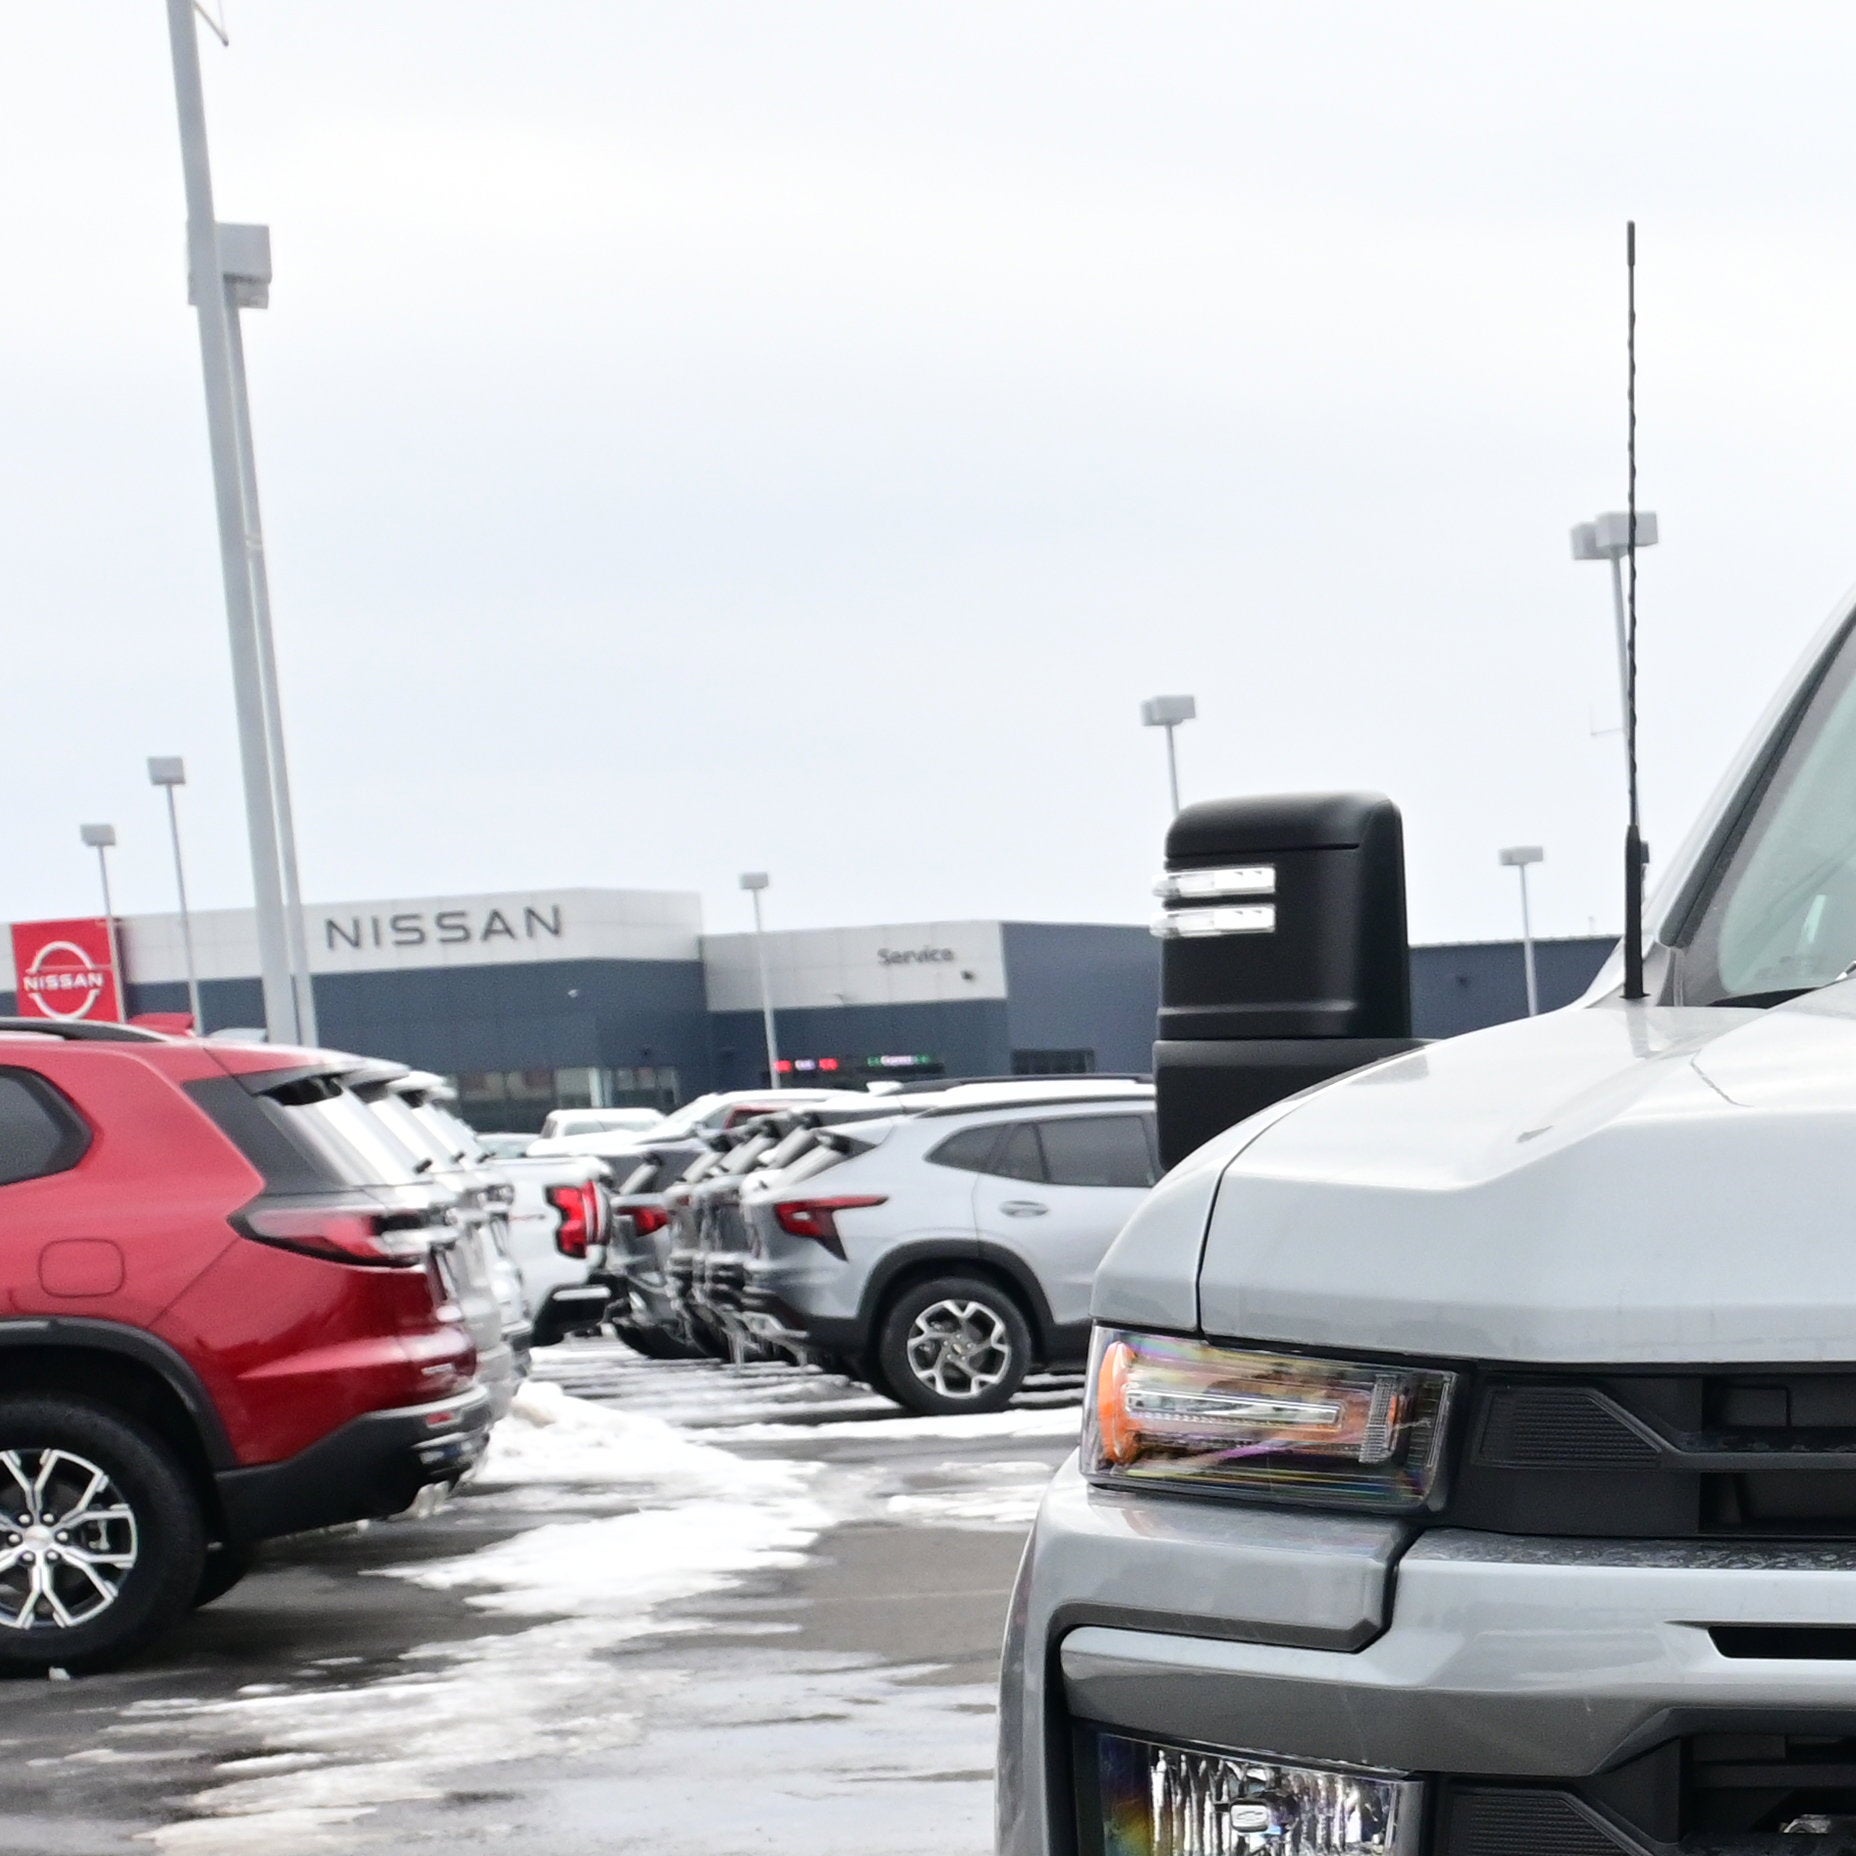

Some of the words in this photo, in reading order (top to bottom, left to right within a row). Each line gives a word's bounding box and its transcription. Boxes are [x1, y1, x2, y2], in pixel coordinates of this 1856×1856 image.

[326, 905, 562, 951] NISSAN
[877, 947, 955, 966] Service
[23, 973, 103, 991] NISSAN
